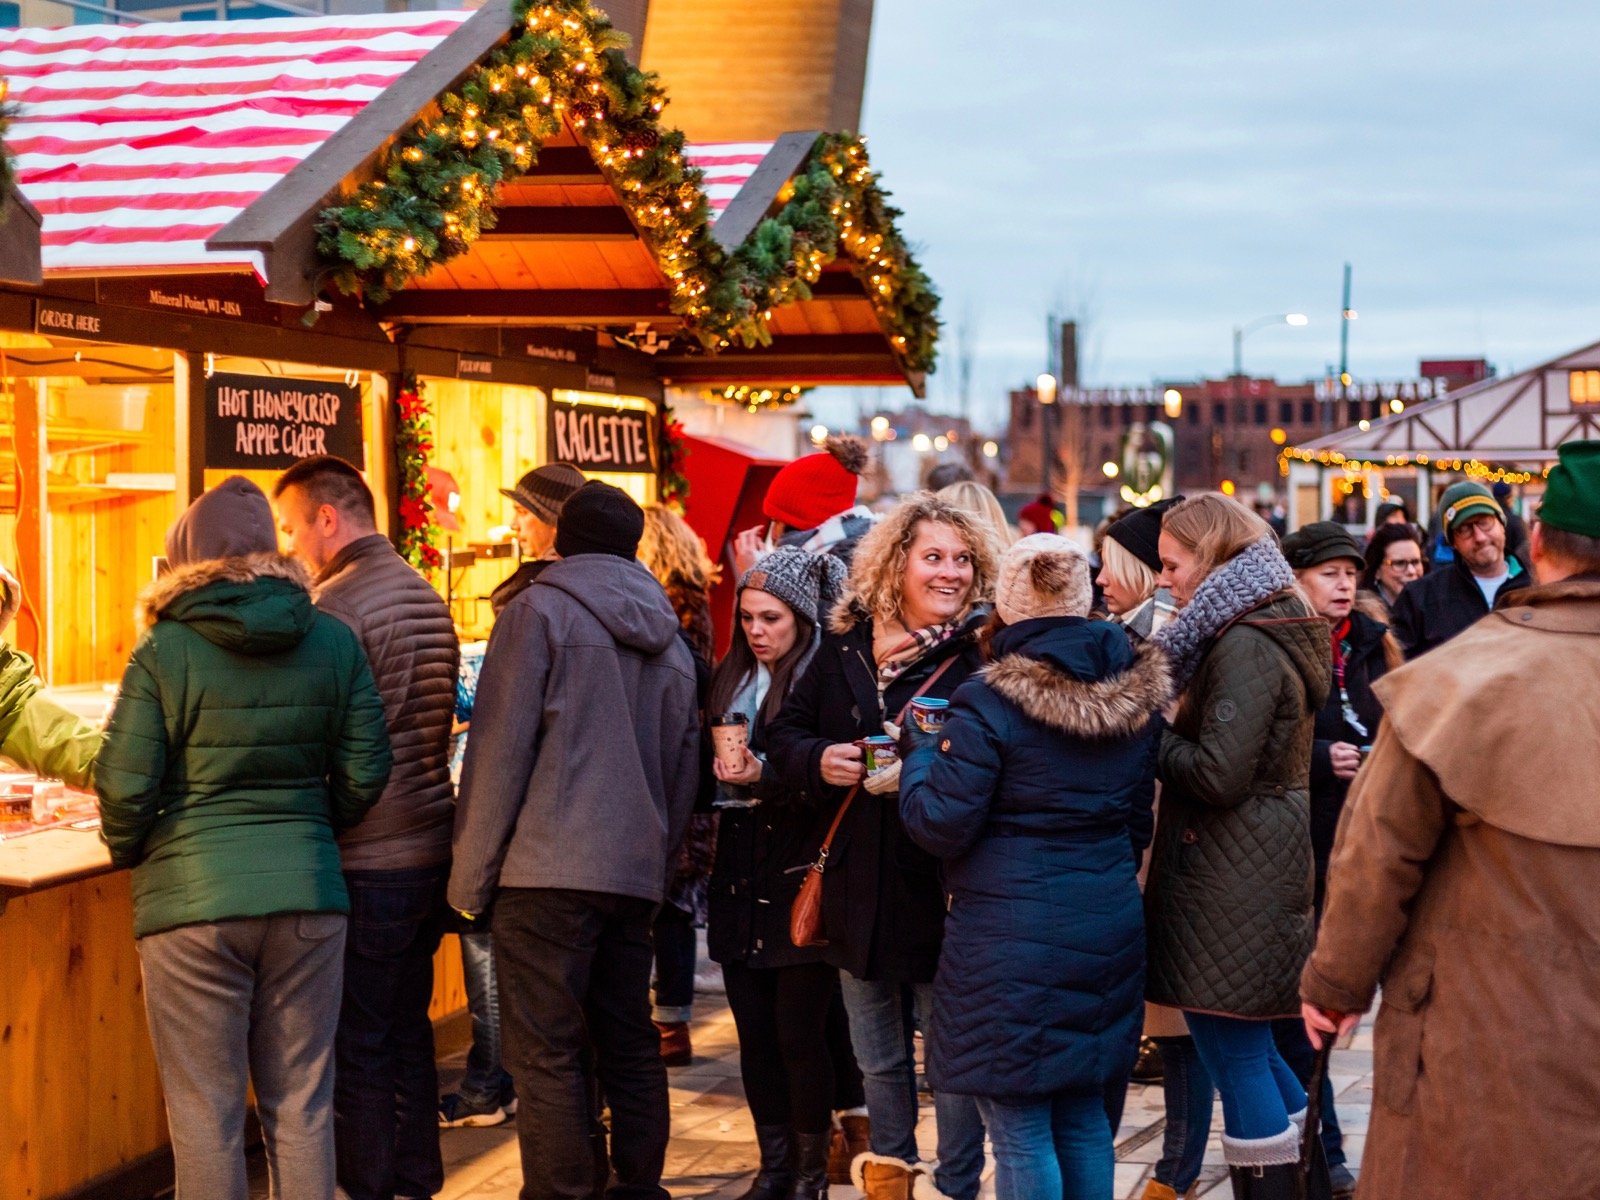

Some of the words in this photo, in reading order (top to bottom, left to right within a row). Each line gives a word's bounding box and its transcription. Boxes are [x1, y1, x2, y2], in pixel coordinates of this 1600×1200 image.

[149, 289, 182, 308] Mineral
[40, 309, 75, 330] ORDER
[76, 314, 100, 333] HERE
[218, 386, 250, 418] HOT
[554, 408, 647, 465] RACLETTE
